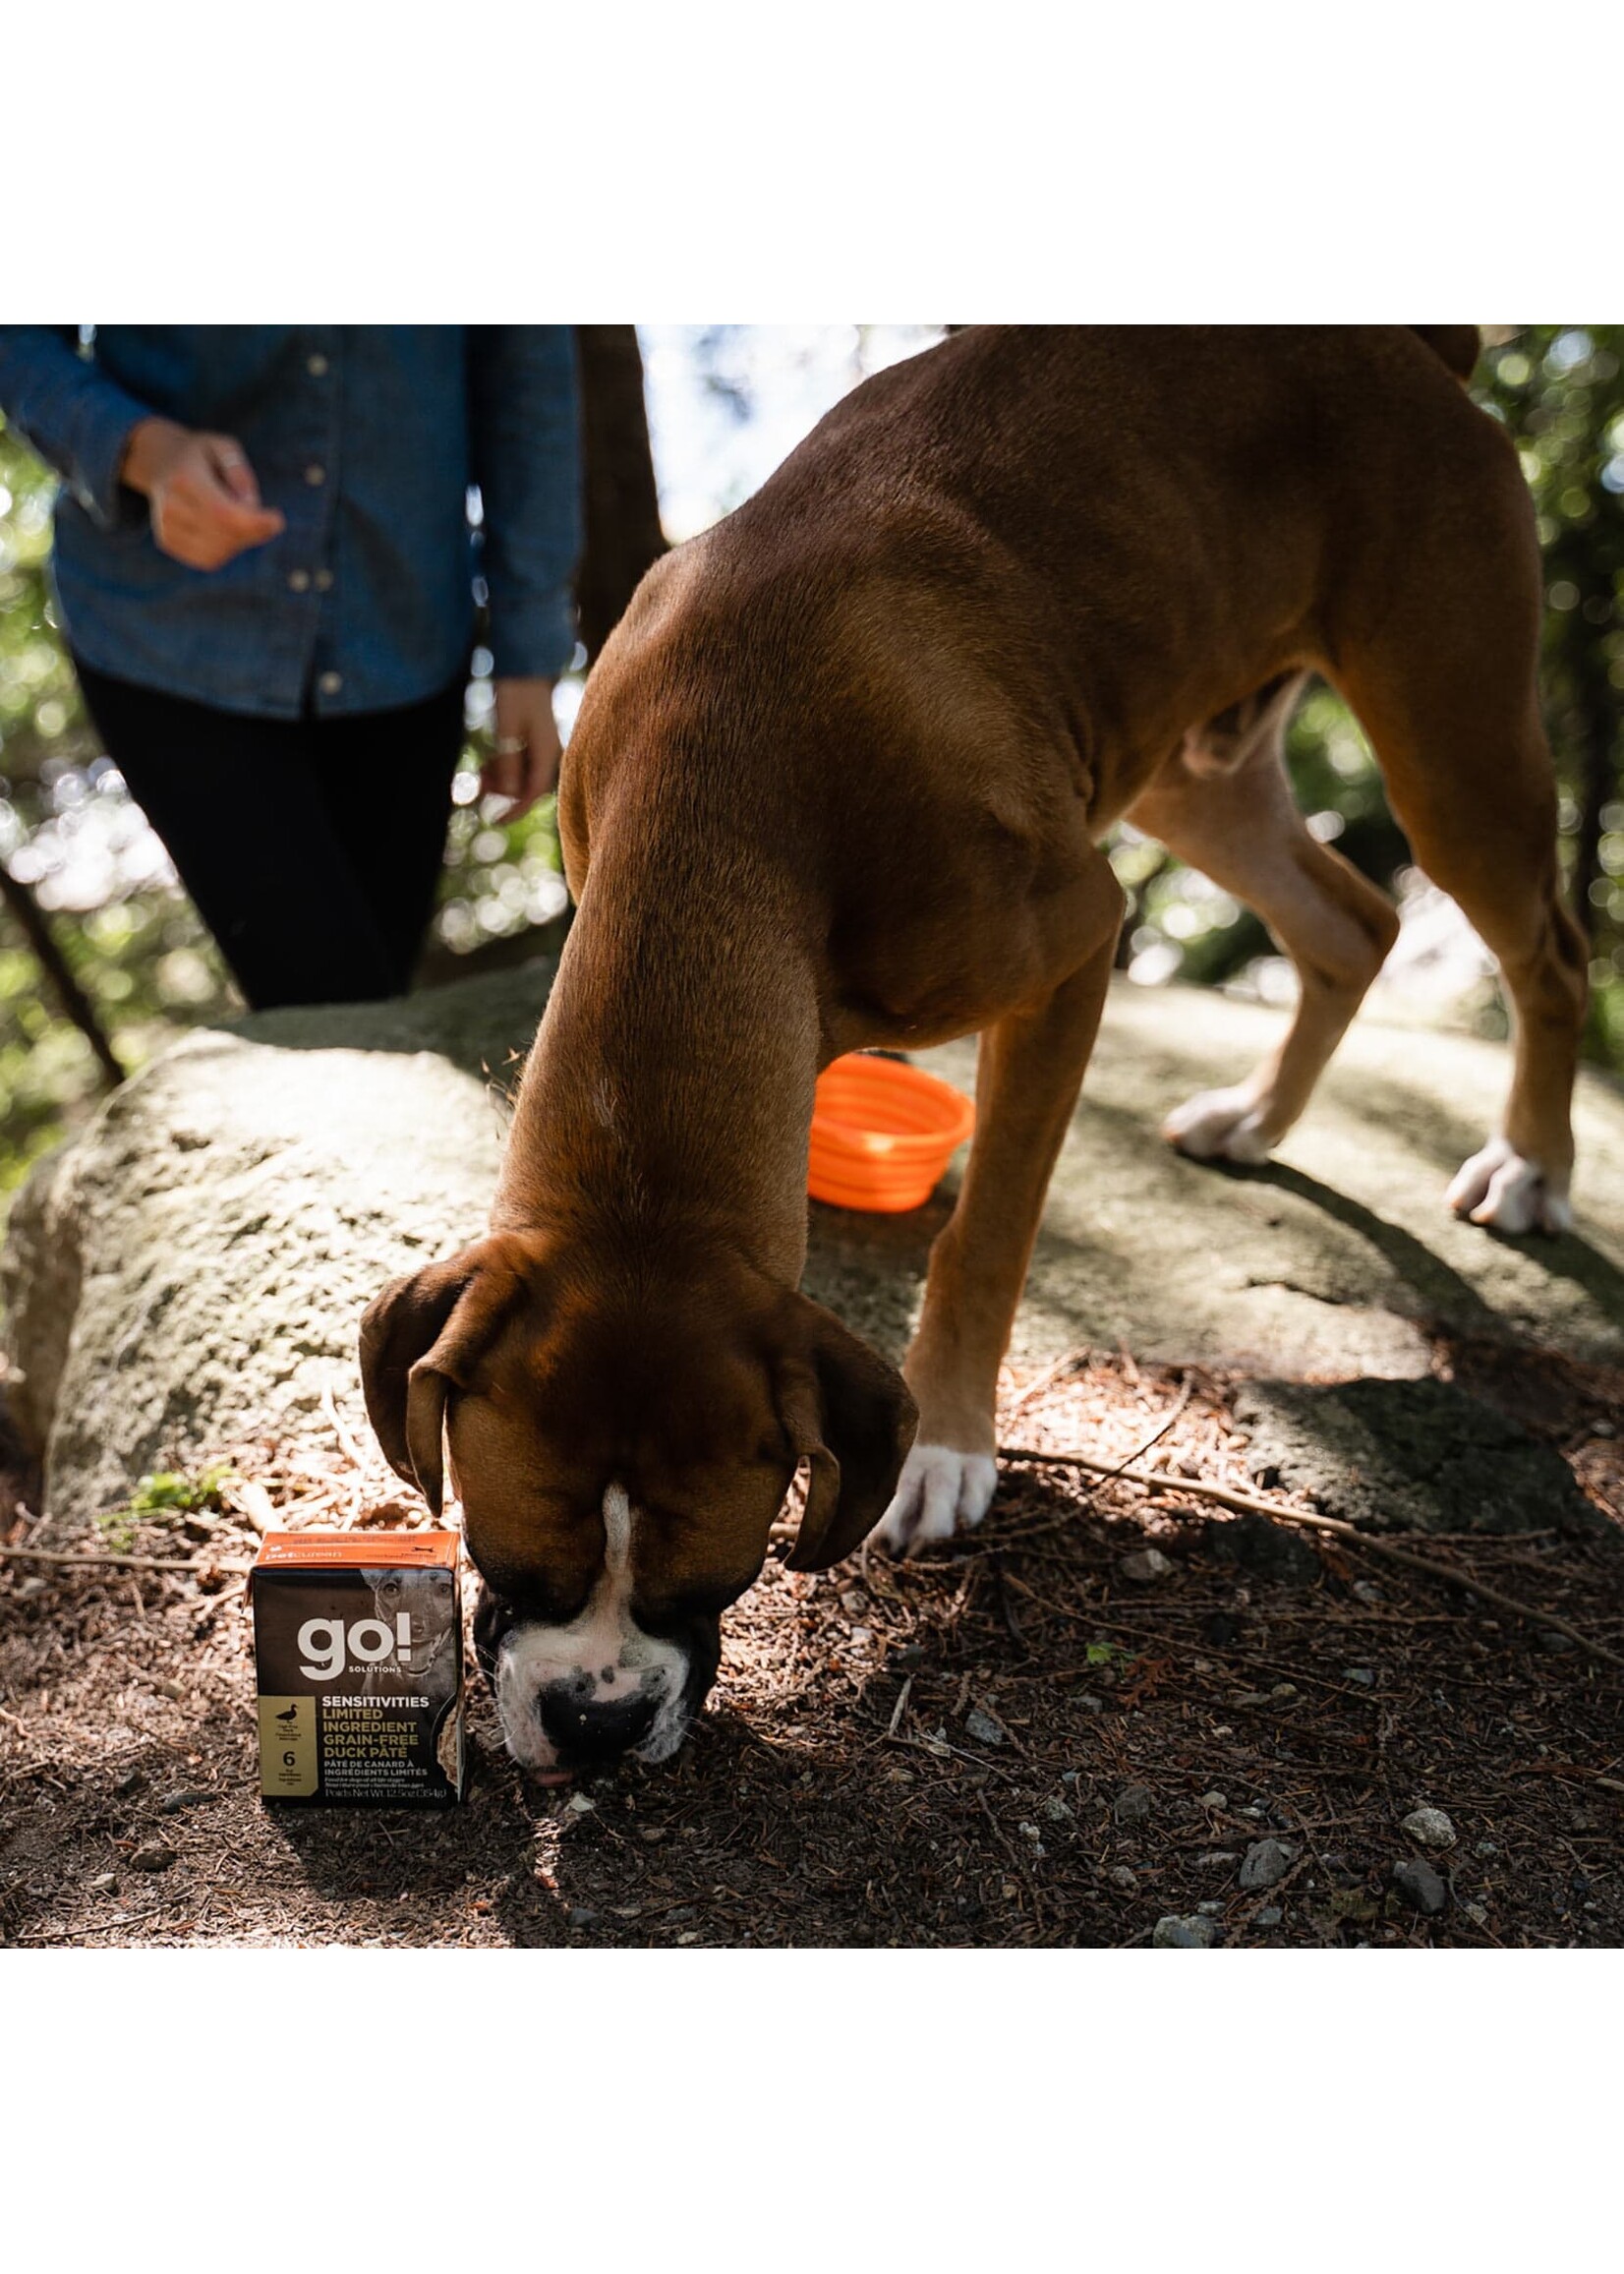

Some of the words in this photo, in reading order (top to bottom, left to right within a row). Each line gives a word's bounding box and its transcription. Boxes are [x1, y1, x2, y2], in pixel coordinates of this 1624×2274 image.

[298, 1611, 411, 1681] go!
[321, 1695, 430, 1708] SENSITIVITIES
[322, 1709, 383, 1720] LIMITED
[322, 1720, 418, 1733] INGREDIENT
[323, 1733, 420, 1746] GRAIN-FREE
[324, 1747, 368, 1758] DUCK
[369, 1744, 408, 1758] PÂTÉ
[282, 1751, 296, 1767] 6
[349, 1760, 363, 1769] DE
[364, 1760, 405, 1769] CANARD
